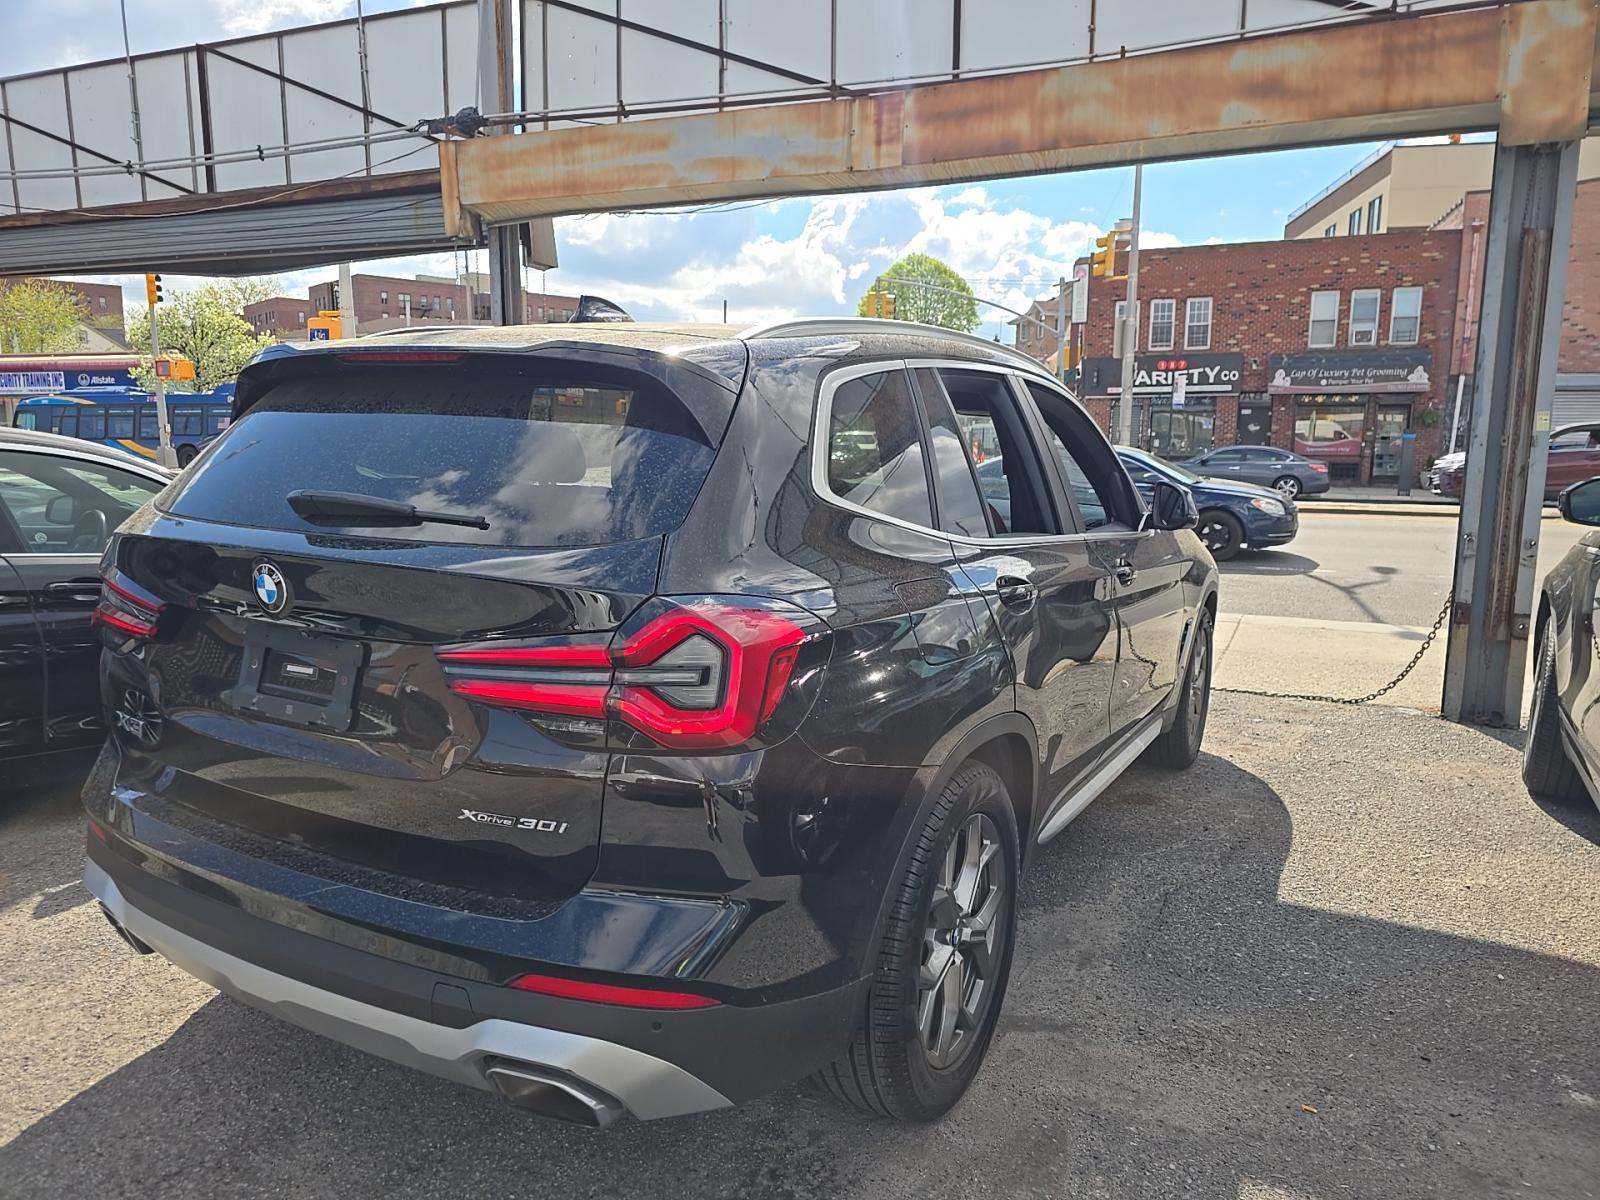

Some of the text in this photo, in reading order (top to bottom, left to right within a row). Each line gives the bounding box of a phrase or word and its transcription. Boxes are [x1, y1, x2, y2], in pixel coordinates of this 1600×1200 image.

[22, 373, 50, 388] TRAINING
[51, 373, 64, 388] INC
[91, 376, 115, 384] Allstate
[1134, 363, 1221, 385] ARIETY
[1290, 367, 1408, 380] Lap Of Luxury Pet Grooming
